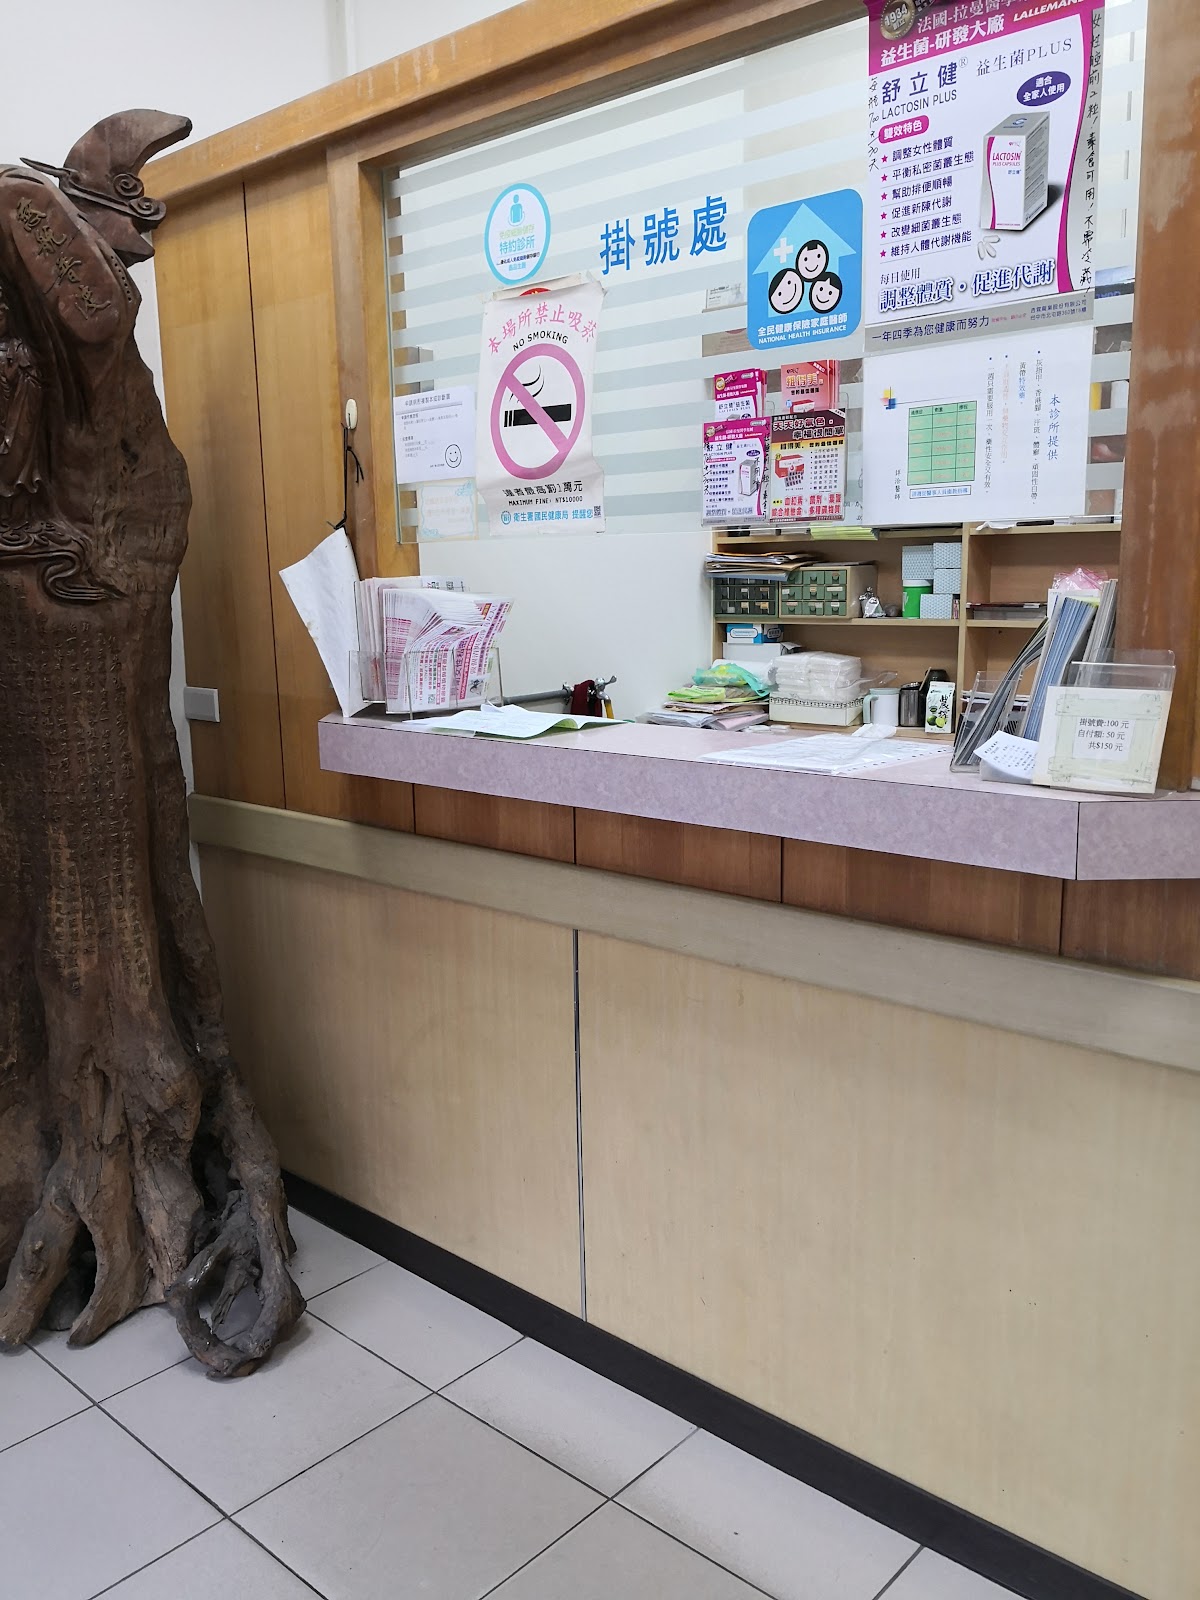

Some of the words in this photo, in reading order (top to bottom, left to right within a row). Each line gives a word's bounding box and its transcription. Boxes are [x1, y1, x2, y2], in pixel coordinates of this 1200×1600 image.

[884, 3, 909, 26] 1934
[1013, 0, 1084, 22] LALLEMAN
[880, 14, 1005, 67] 益生菌-研發大廠
[977, 38, 1072, 76] 益生菌PLUS
[1022, 83, 1065, 102] 全家人使用
[1035, 75, 1053, 88] 適合
[881, 97, 930, 120] LACTOSIN
[932, 89, 957, 106] PLUS
[883, 120, 923, 140] 雙效特色
[892, 136, 954, 161] 調整女性體質
[992, 152, 1021, 161] LACTOSIN
[892, 176, 953, 200] 幫助排便順暢
[891, 195, 952, 219] 促進新陳代謝
[499, 235, 535, 255] 特約診所
[599, 195, 727, 275] 掛號處
[890, 230, 972, 257] 維持人體代謝機能
[880, 267, 921, 285] 每日使用
[488, 301, 597, 356] 本場所禁止吸菸
[757, 312, 848, 337] 全民健康保險家庭醫師
[758, 334, 787, 345] NATIONAL
[788, 330, 811, 340] HEALTH
[812, 324, 847, 336] INSURANCE
[871, 316, 990, 342] 一年四季為您健康而努力
[513, 338, 525, 351] NO
[527, 330, 569, 345] SMOKING
[1047, 393, 1062, 461] 本診所提供
[508, 499, 533, 507] MAXIMUM
[513, 509, 569, 522] 衛生署國民健康局
[571, 508, 594, 520] 提醒您
[1120, 720, 1130, 729] 元
[1114, 742, 1123, 752] 元
[1116, 731, 1126, 741] 元
